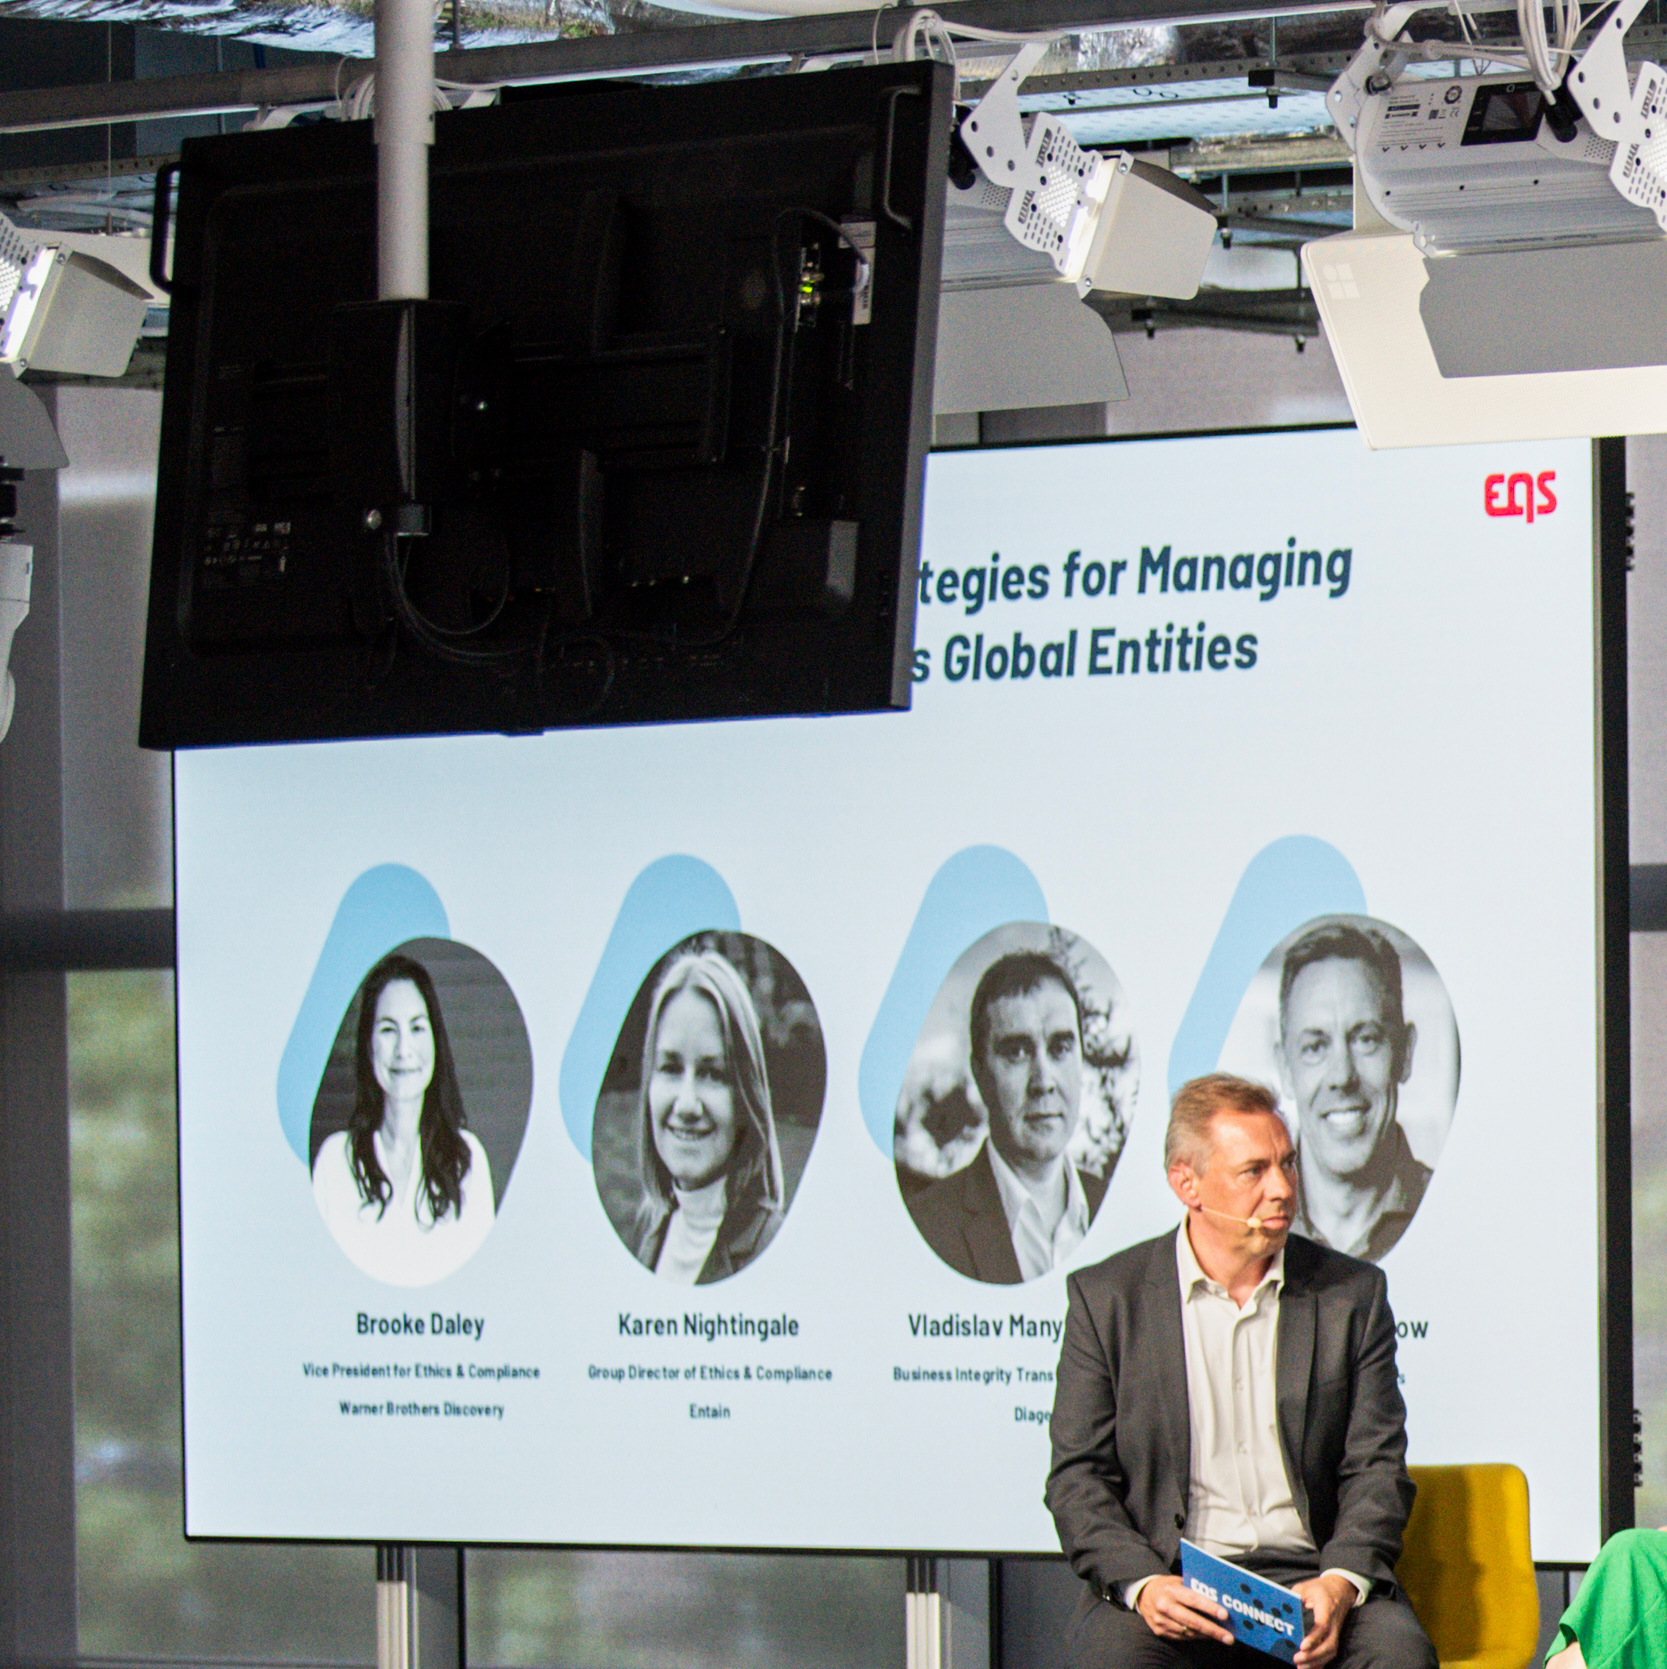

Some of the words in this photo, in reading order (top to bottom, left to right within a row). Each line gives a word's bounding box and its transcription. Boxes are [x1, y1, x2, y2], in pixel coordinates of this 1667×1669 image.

[1485, 471, 1557, 523] EQS
[918, 552, 1049, 615] tegies
[1063, 550, 1127, 597] for
[1138, 536, 1352, 601] Managing
[944, 629, 1077, 682] Global
[1088, 621, 1258, 675] Entities
[356, 1312, 425, 1335] Brooke
[430, 1312, 485, 1341] Daley
[618, 1313, 678, 1336] Karen
[683, 1312, 799, 1342] Nightingale
[908, 1313, 1003, 1337] Vladislav
[1008, 1313, 1063, 1343] Many
[302, 1363, 329, 1378] Vice
[331, 1362, 391, 1378] President
[392, 1363, 412, 1378] for
[414, 1363, 453, 1379] Ethics
[455, 1364, 465, 1379] &
[468, 1363, 541, 1382] Compliance
[587, 1364, 626, 1383] Group
[627, 1364, 680, 1380] Director
[684, 1365, 697, 1380] of
[699, 1364, 740, 1381] Ethics
[743, 1365, 753, 1380] &
[755, 1365, 833, 1384] Compliance
[892, 1366, 953, 1382] Business
[955, 1367, 1012, 1386] Integrity
[1016, 1366, 1054, 1383] Trans
[339, 1401, 384, 1415] Warner
[385, 1400, 440, 1416] Brothers
[443, 1401, 505, 1420] Discovery
[689, 1403, 731, 1419] Entain
[1013, 1405, 1052, 1426] Diage
[1222, 1594, 1294, 1637] CONNECT
